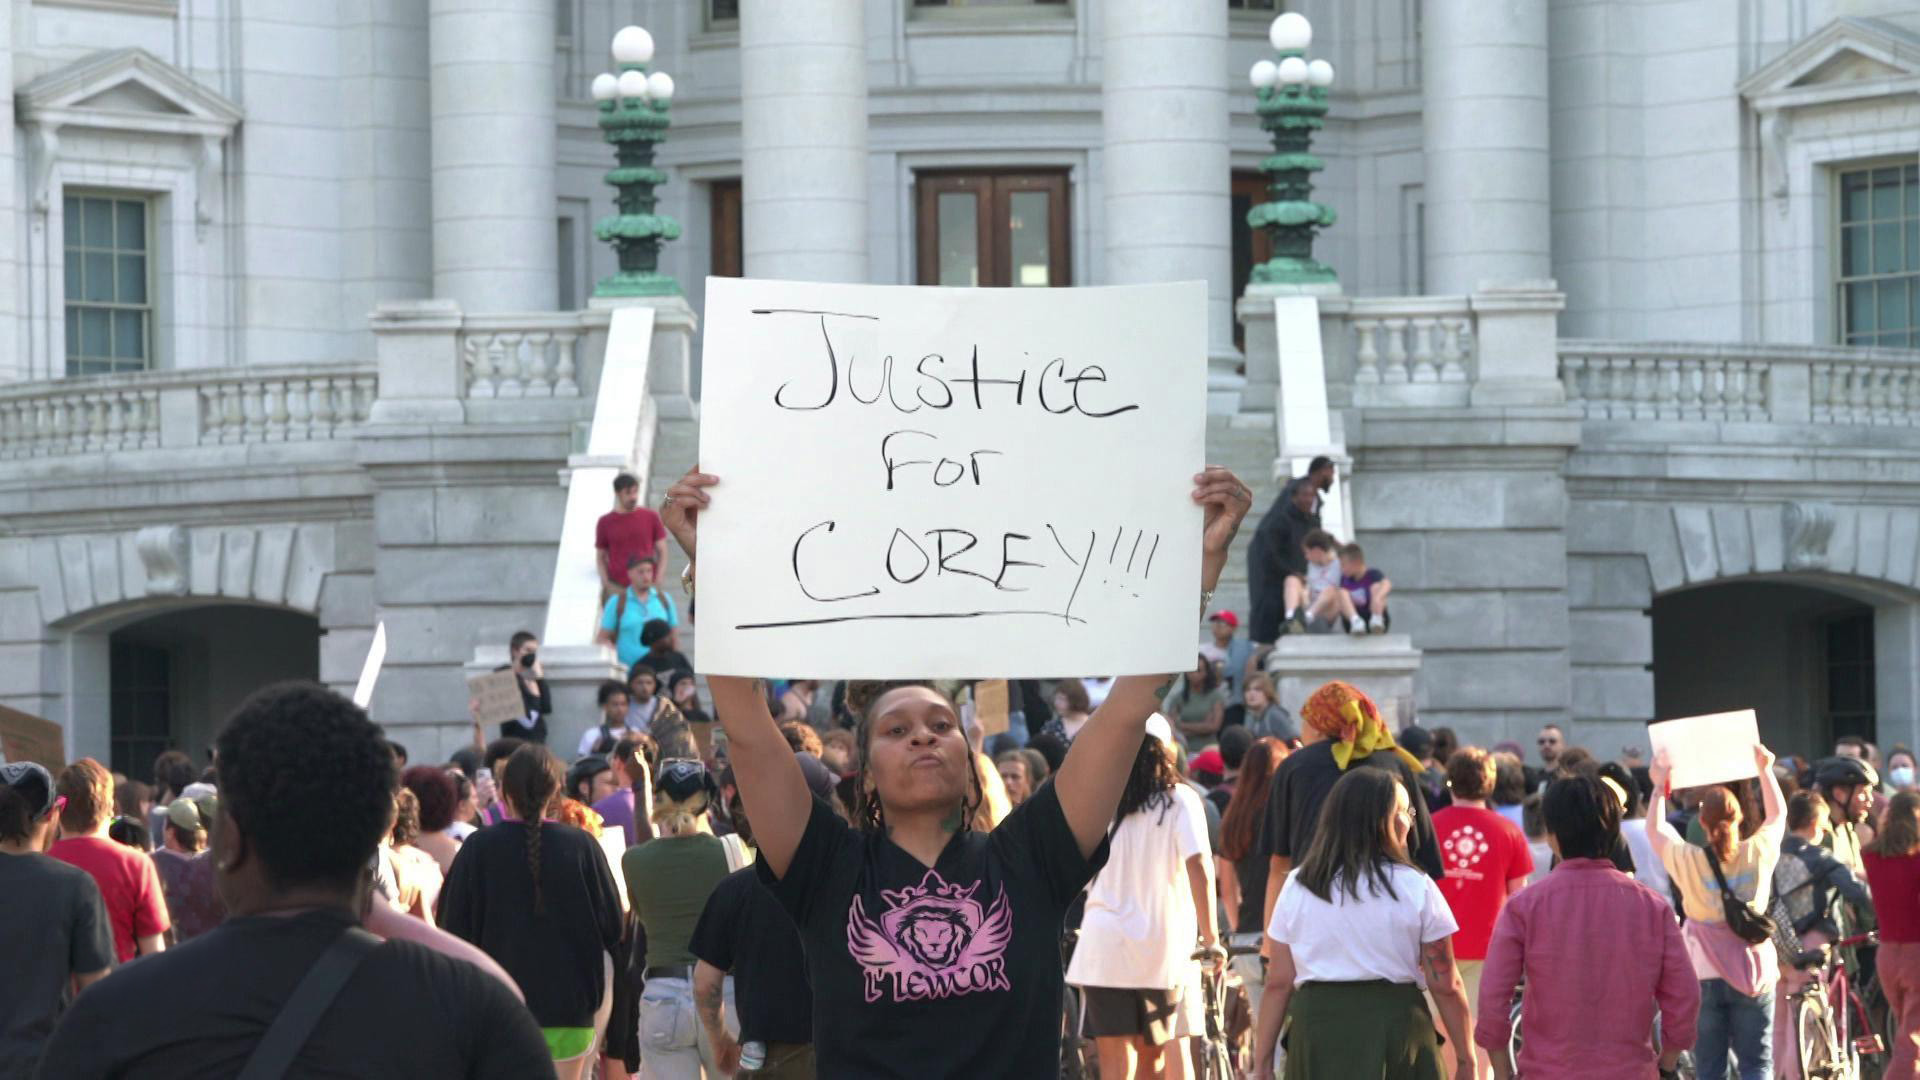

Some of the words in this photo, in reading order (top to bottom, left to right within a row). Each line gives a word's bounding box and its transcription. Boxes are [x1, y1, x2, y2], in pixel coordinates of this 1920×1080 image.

[750, 309, 1140, 418] Justice
[881, 430, 1003, 491] For
[792, 520, 1159, 626] COREY!!!
